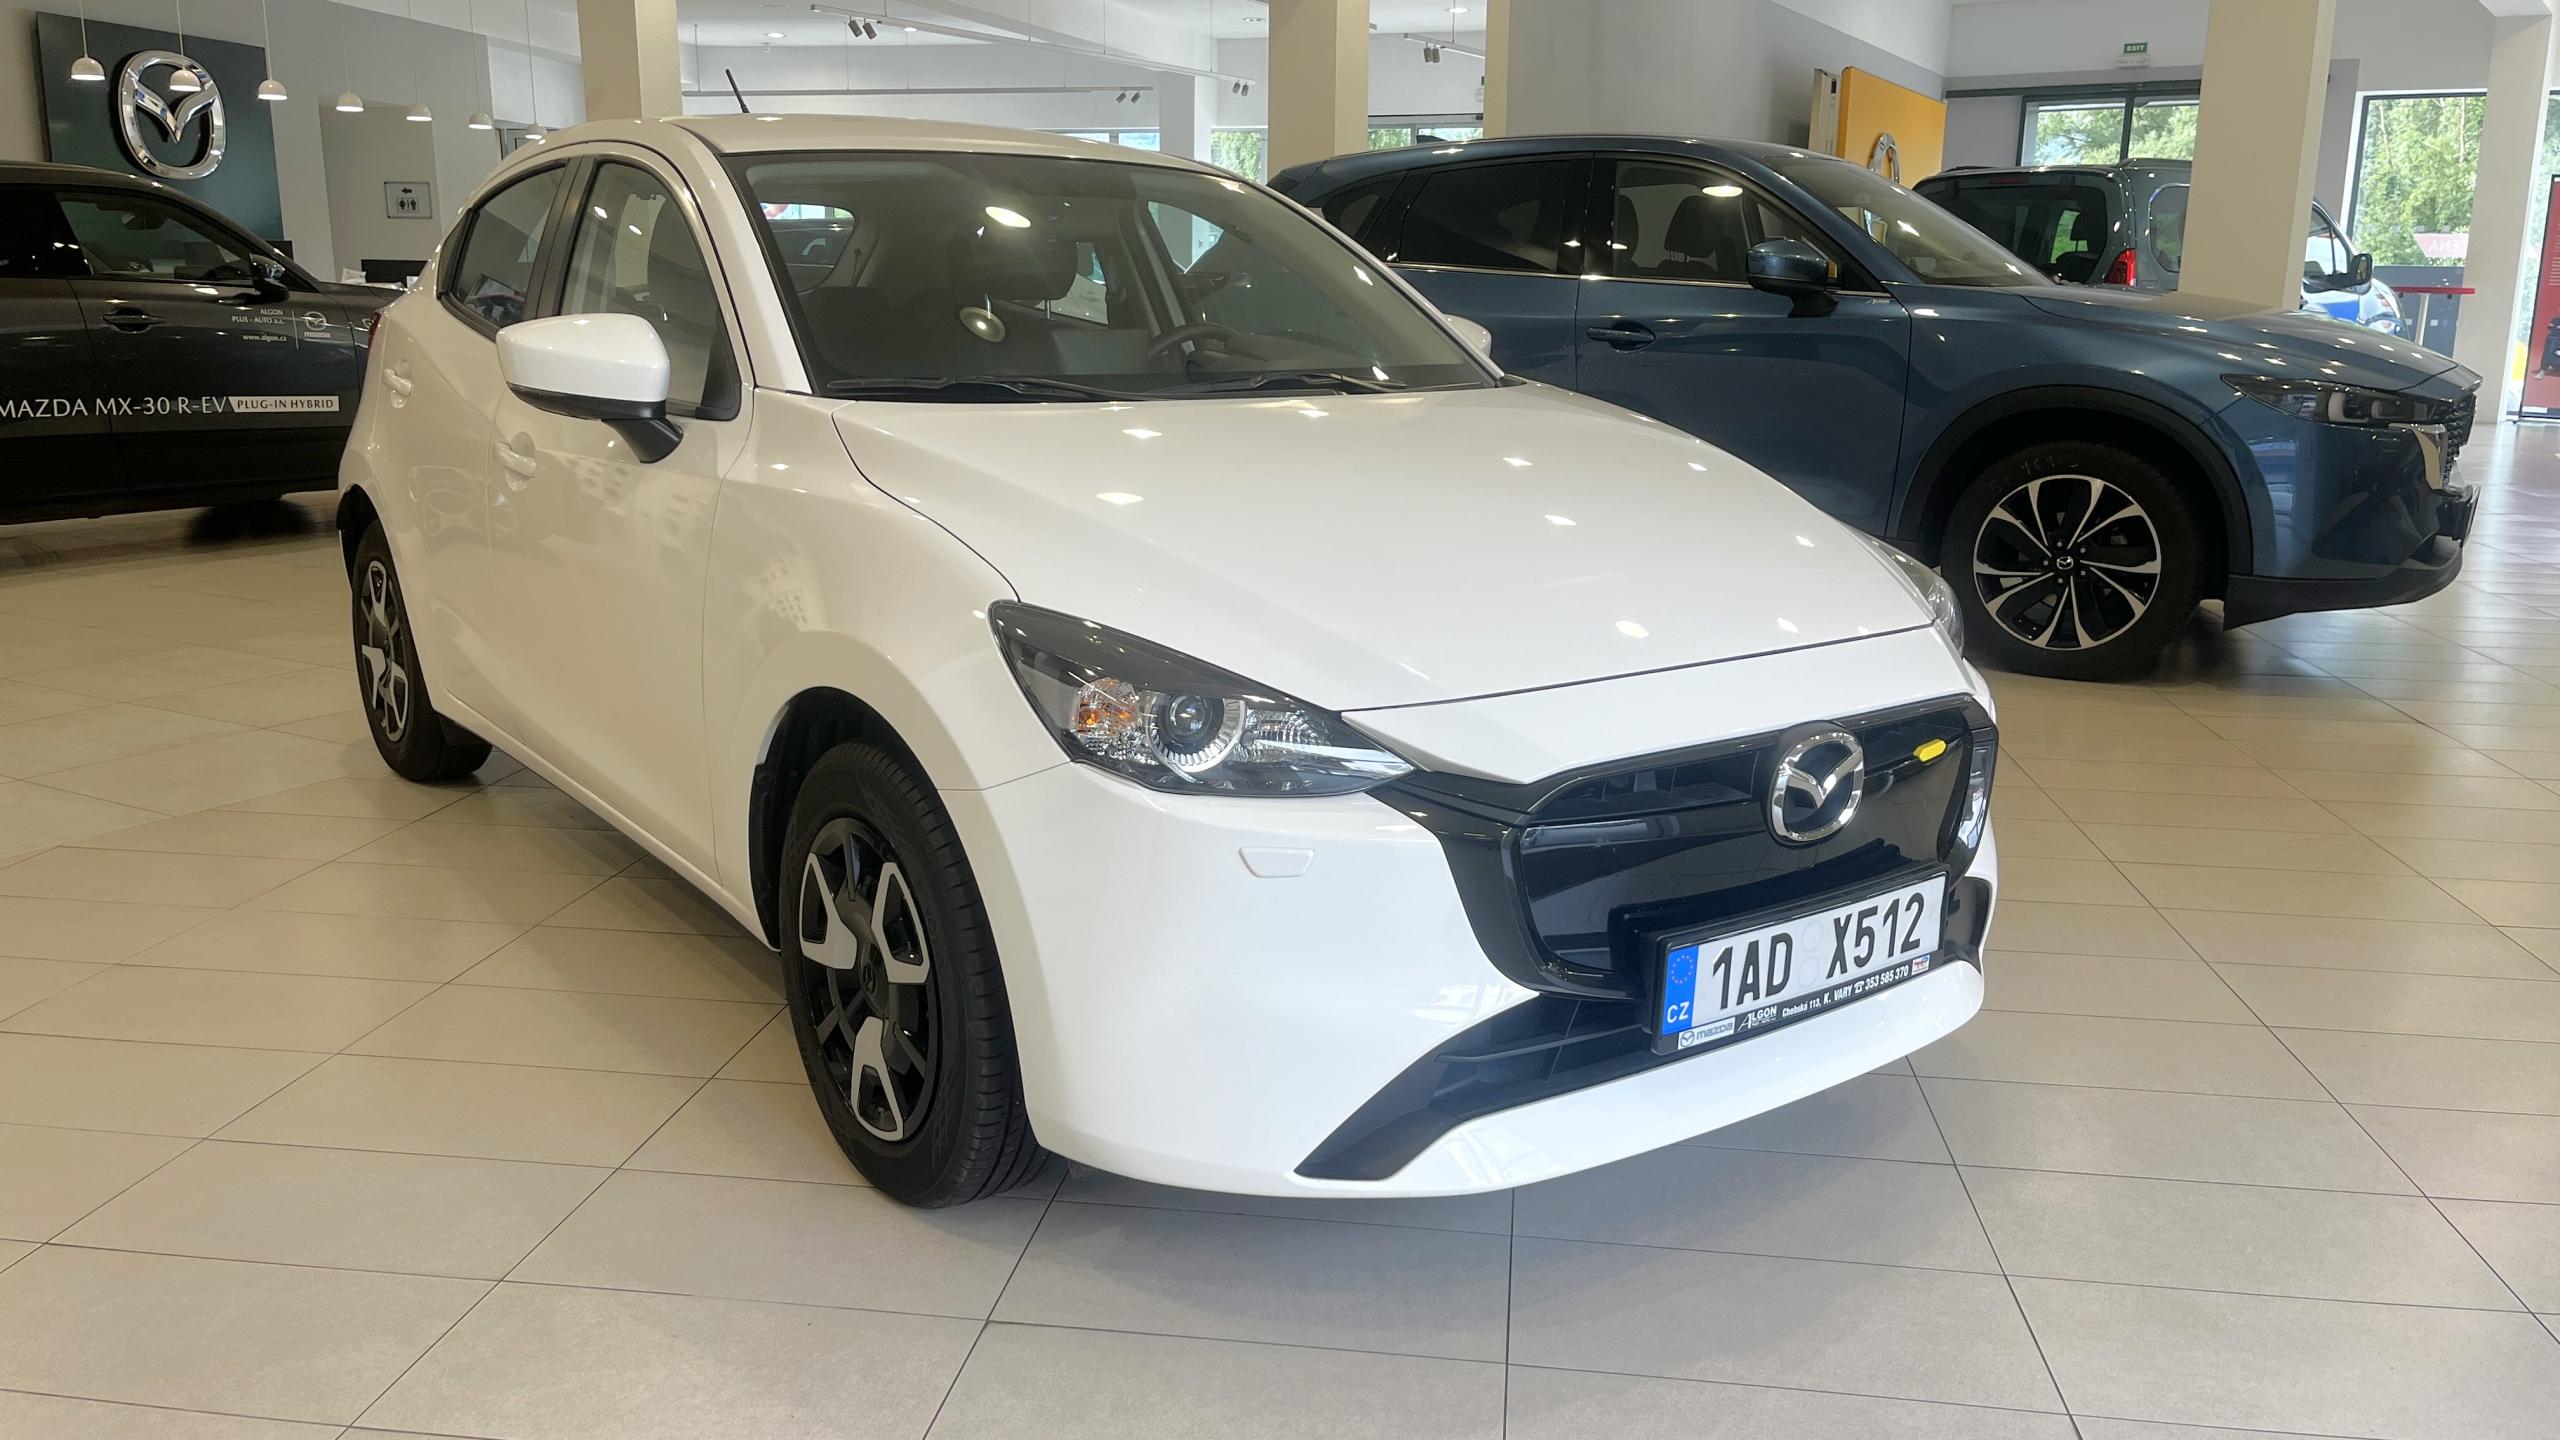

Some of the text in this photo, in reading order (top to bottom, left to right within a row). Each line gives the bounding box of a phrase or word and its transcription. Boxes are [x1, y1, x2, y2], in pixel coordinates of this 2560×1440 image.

[232, 315, 249, 323] PLUS
[254, 316, 273, 324] AUTO
[260, 308, 284, 316] ALGON
[242, 334, 287, 343] www.algon.cz
[0, 396, 334, 418] MAZDA MX-30 R-EV PLUG-IN HYBRID
[1711, 892, 1925, 1010] 1AD X512
[1782, 1000, 1809, 1018] Chebská
[1823, 992, 1832, 1005] K.
[1834, 984, 1853, 1001] VARY
[1865, 975, 1880, 991] 353
[1880, 971, 1894, 986] 585
[1895, 964, 1909, 981] 370
[1667, 1001, 1690, 1024] CZ
[1737, 1005, 1777, 1032] ALGON
[1696, 1021, 1734, 1041] mazda
